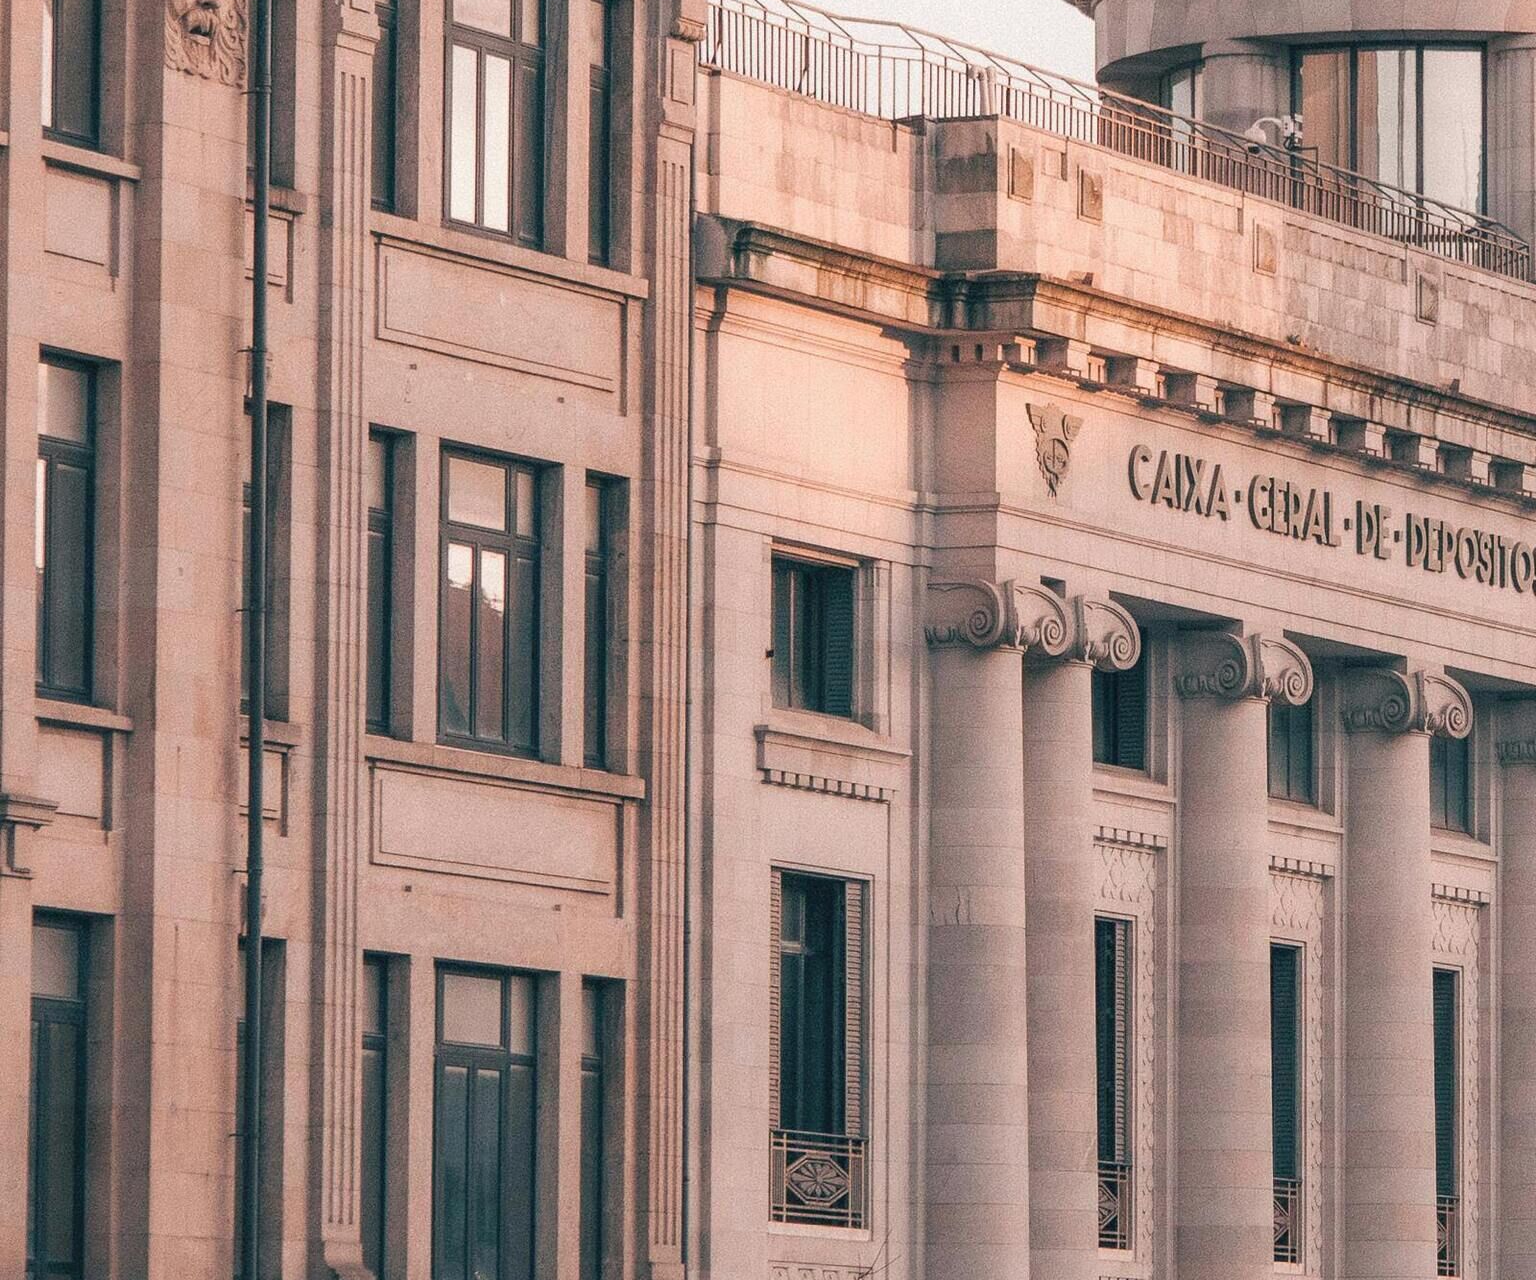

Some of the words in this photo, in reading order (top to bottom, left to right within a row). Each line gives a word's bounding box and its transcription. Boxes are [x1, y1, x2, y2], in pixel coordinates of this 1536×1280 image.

[1128, 444, 1231, 521] CAIXA
[1247, 474, 1341, 548] GERAL
[1355, 499, 1392, 560] DE
